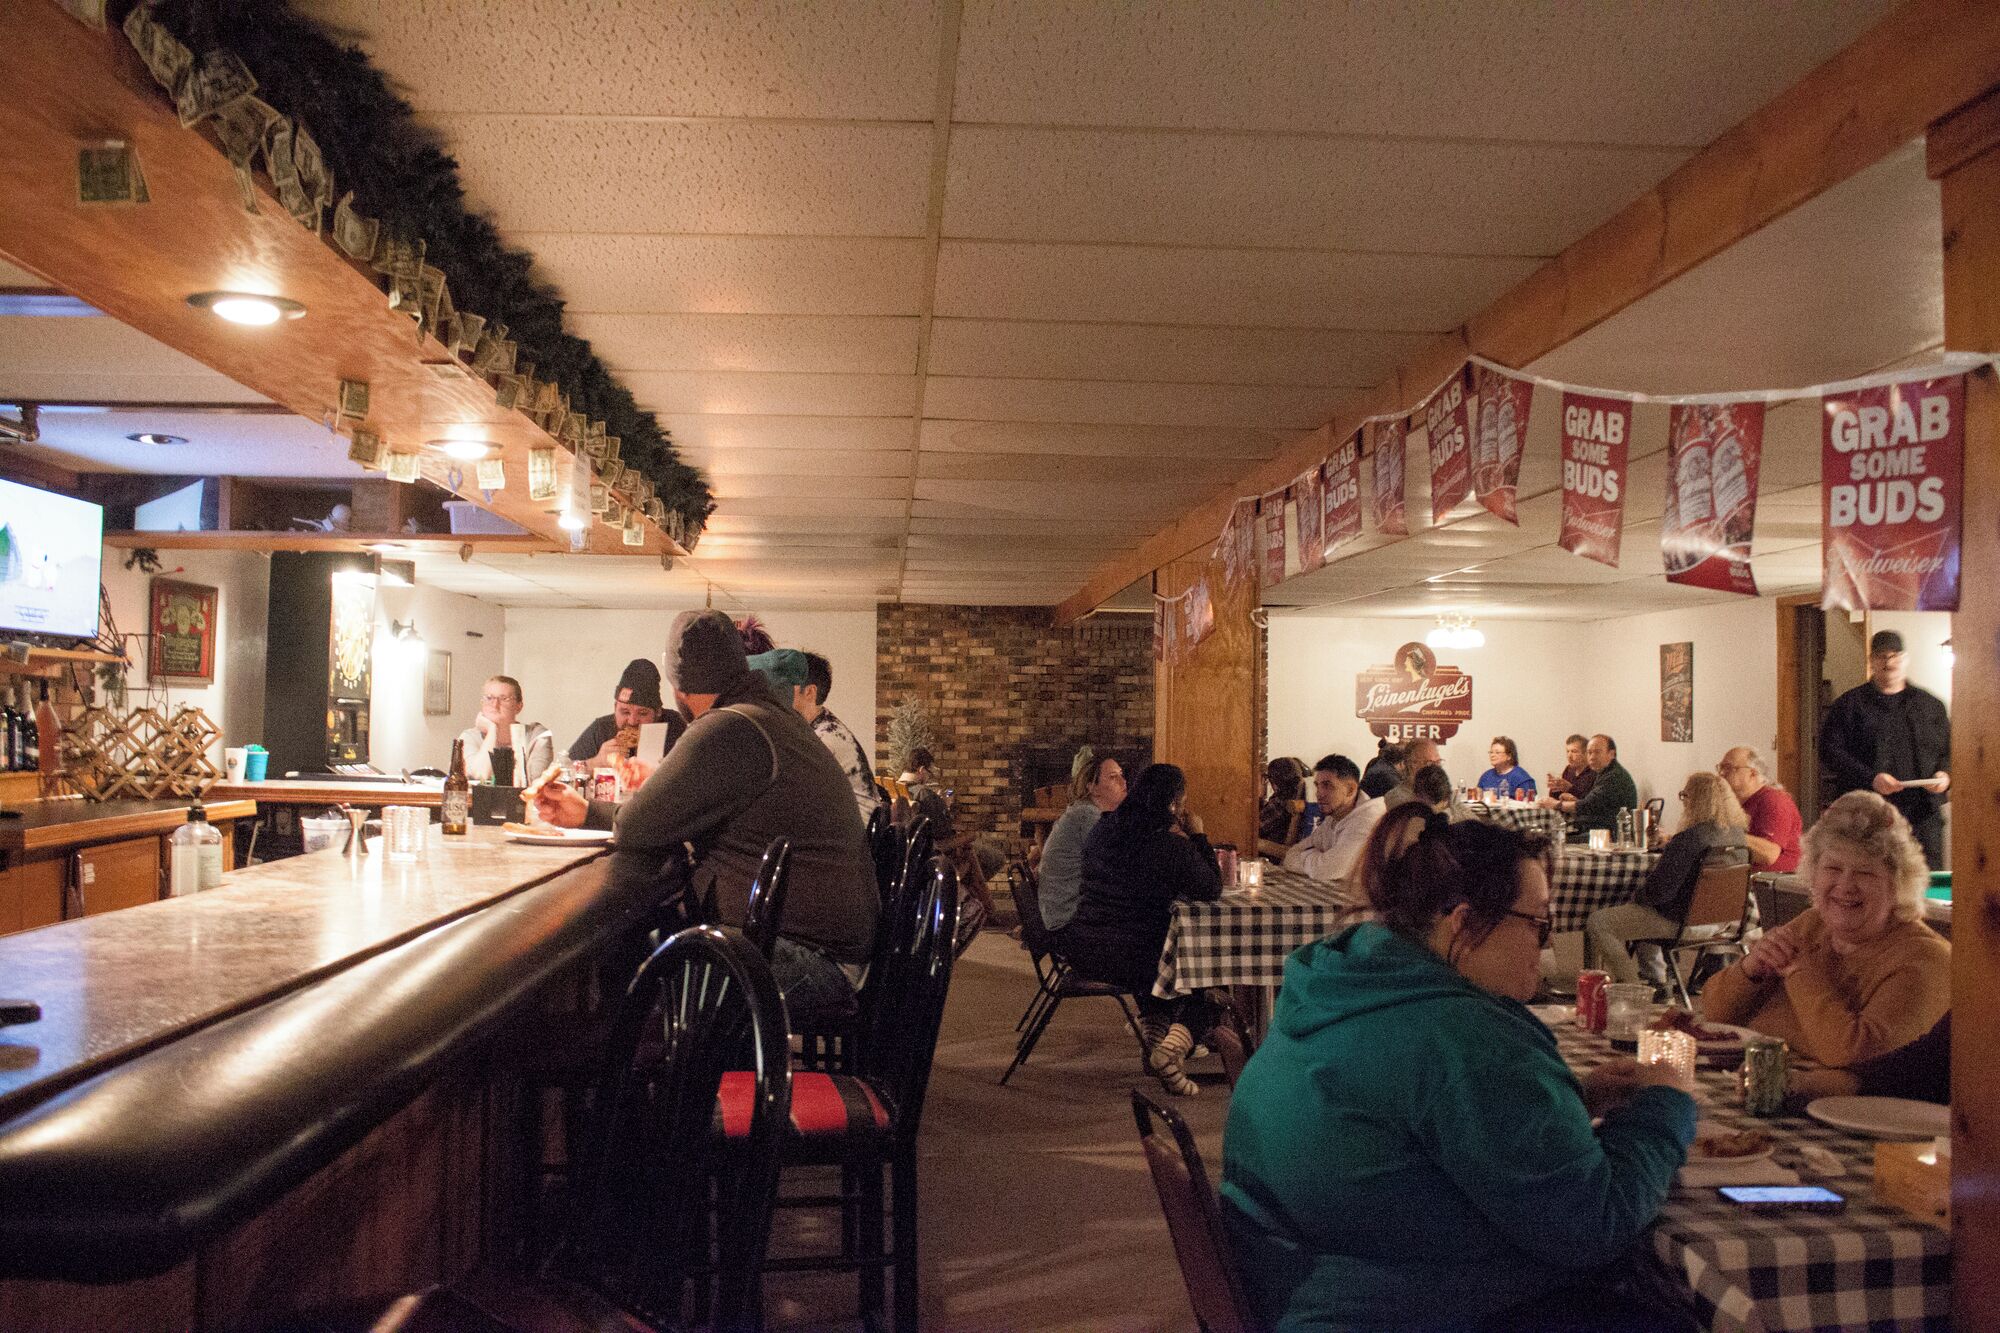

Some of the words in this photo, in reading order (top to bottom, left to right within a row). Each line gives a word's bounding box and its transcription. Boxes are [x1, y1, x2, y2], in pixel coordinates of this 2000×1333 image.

[1428, 380, 1462, 432] GRAB
[1564, 405, 1624, 445] GRAB
[1831, 395, 1950, 452] GRAB
[1326, 440, 1356, 479] GRAB
[1431, 425, 1465, 474] BUDS
[1572, 440, 1610, 465] SOME
[1850, 446, 1927, 480] SOME
[1326, 478, 1358, 513] BUDS
[1563, 458, 1619, 502] BUDS
[1830, 477, 1945, 527] BUDS
[1358, 677, 1470, 714] Leinenkugel's
[1388, 724, 1441, 739] BEER
